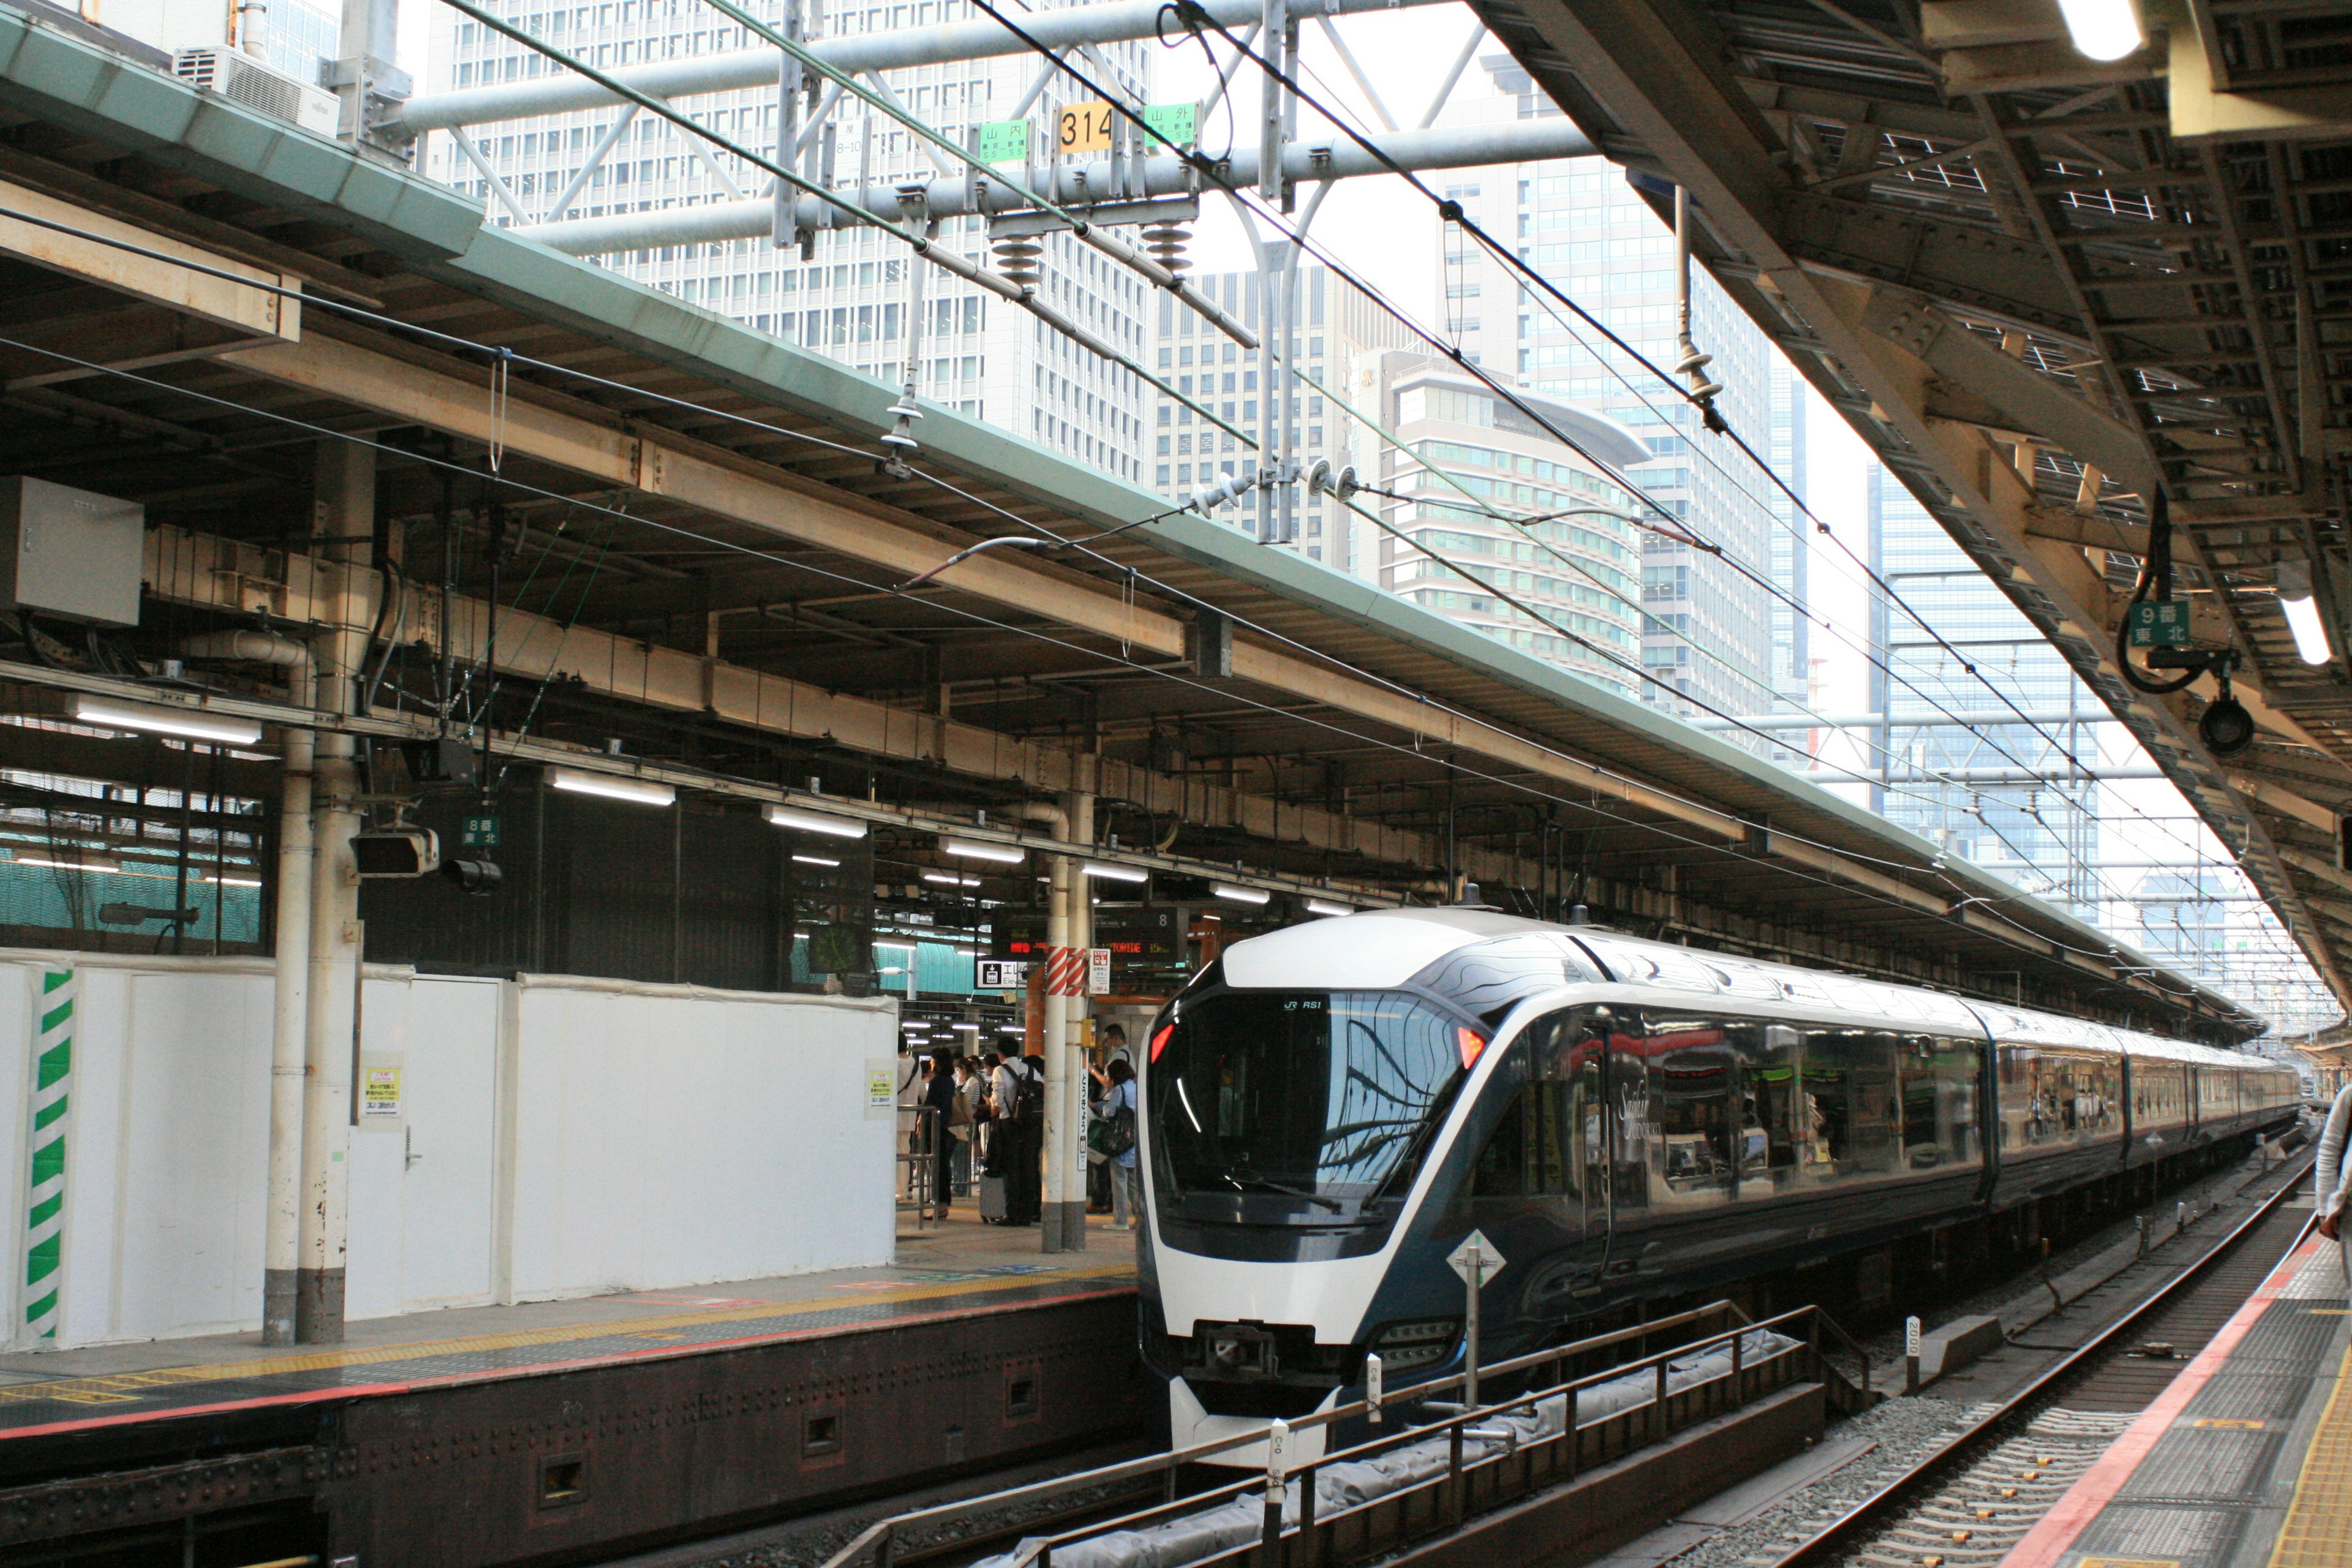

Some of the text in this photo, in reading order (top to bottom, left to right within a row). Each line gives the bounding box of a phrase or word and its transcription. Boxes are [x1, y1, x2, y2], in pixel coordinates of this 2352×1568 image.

[1061, 108, 1112, 146] 314
[2142, 605, 2177, 624] 9番
[469, 820, 492, 831] 8番
[1159, 914, 1167, 926] 8
[1112, 943, 1141, 953] TORIDE
[1909, 1322, 1918, 1354] 2000
